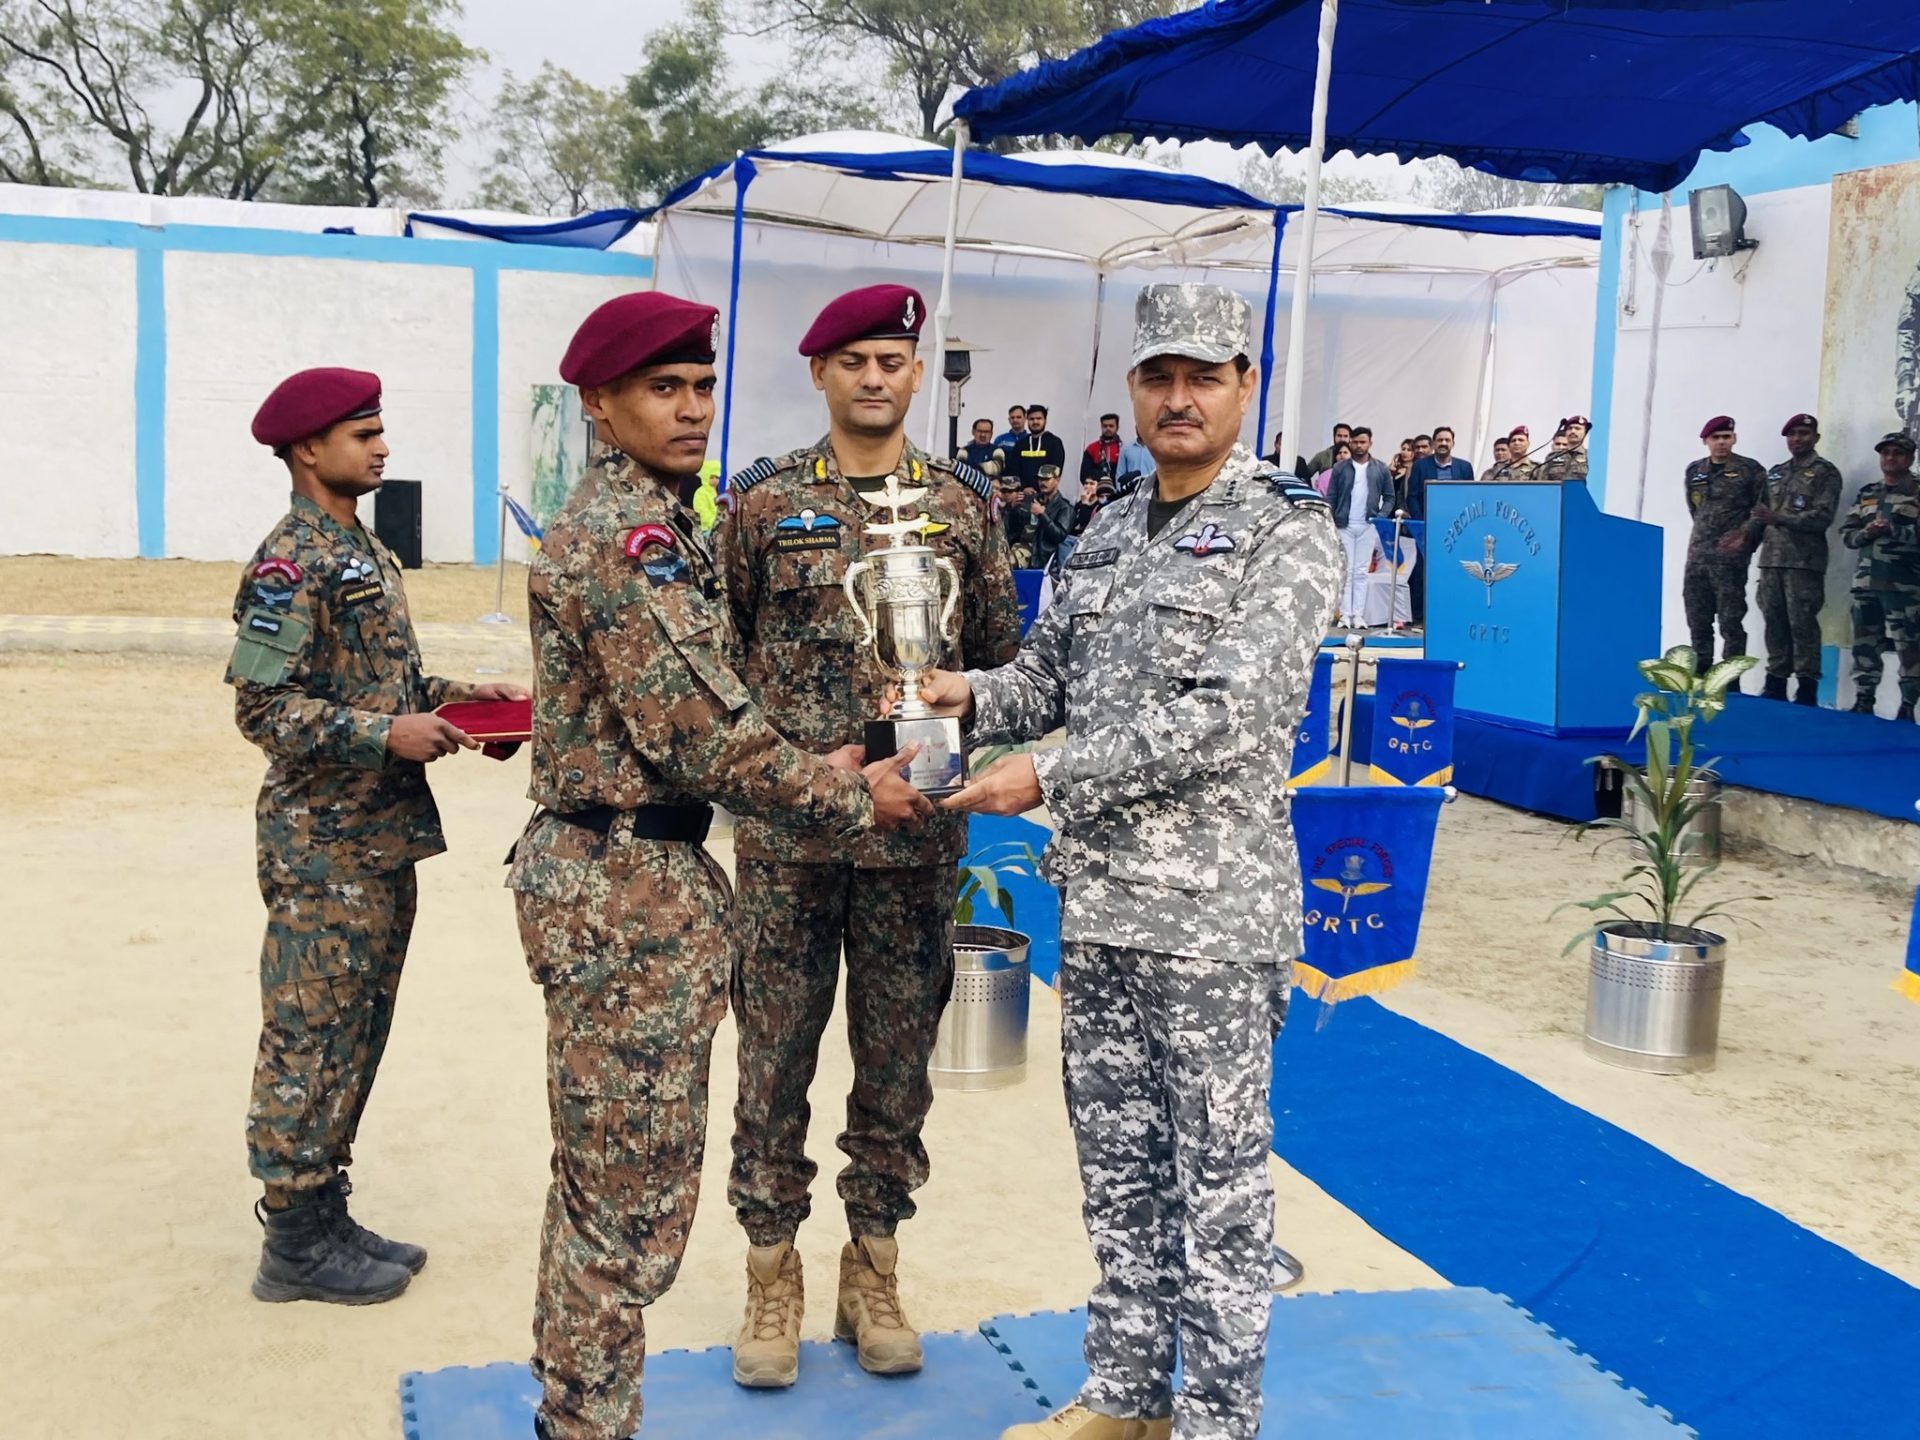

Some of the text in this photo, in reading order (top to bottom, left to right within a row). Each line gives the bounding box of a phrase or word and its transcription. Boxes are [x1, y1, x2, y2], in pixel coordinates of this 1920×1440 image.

[1443, 500, 1541, 557] SPECIAL FORCES
[1304, 909, 1385, 935] GRTC
